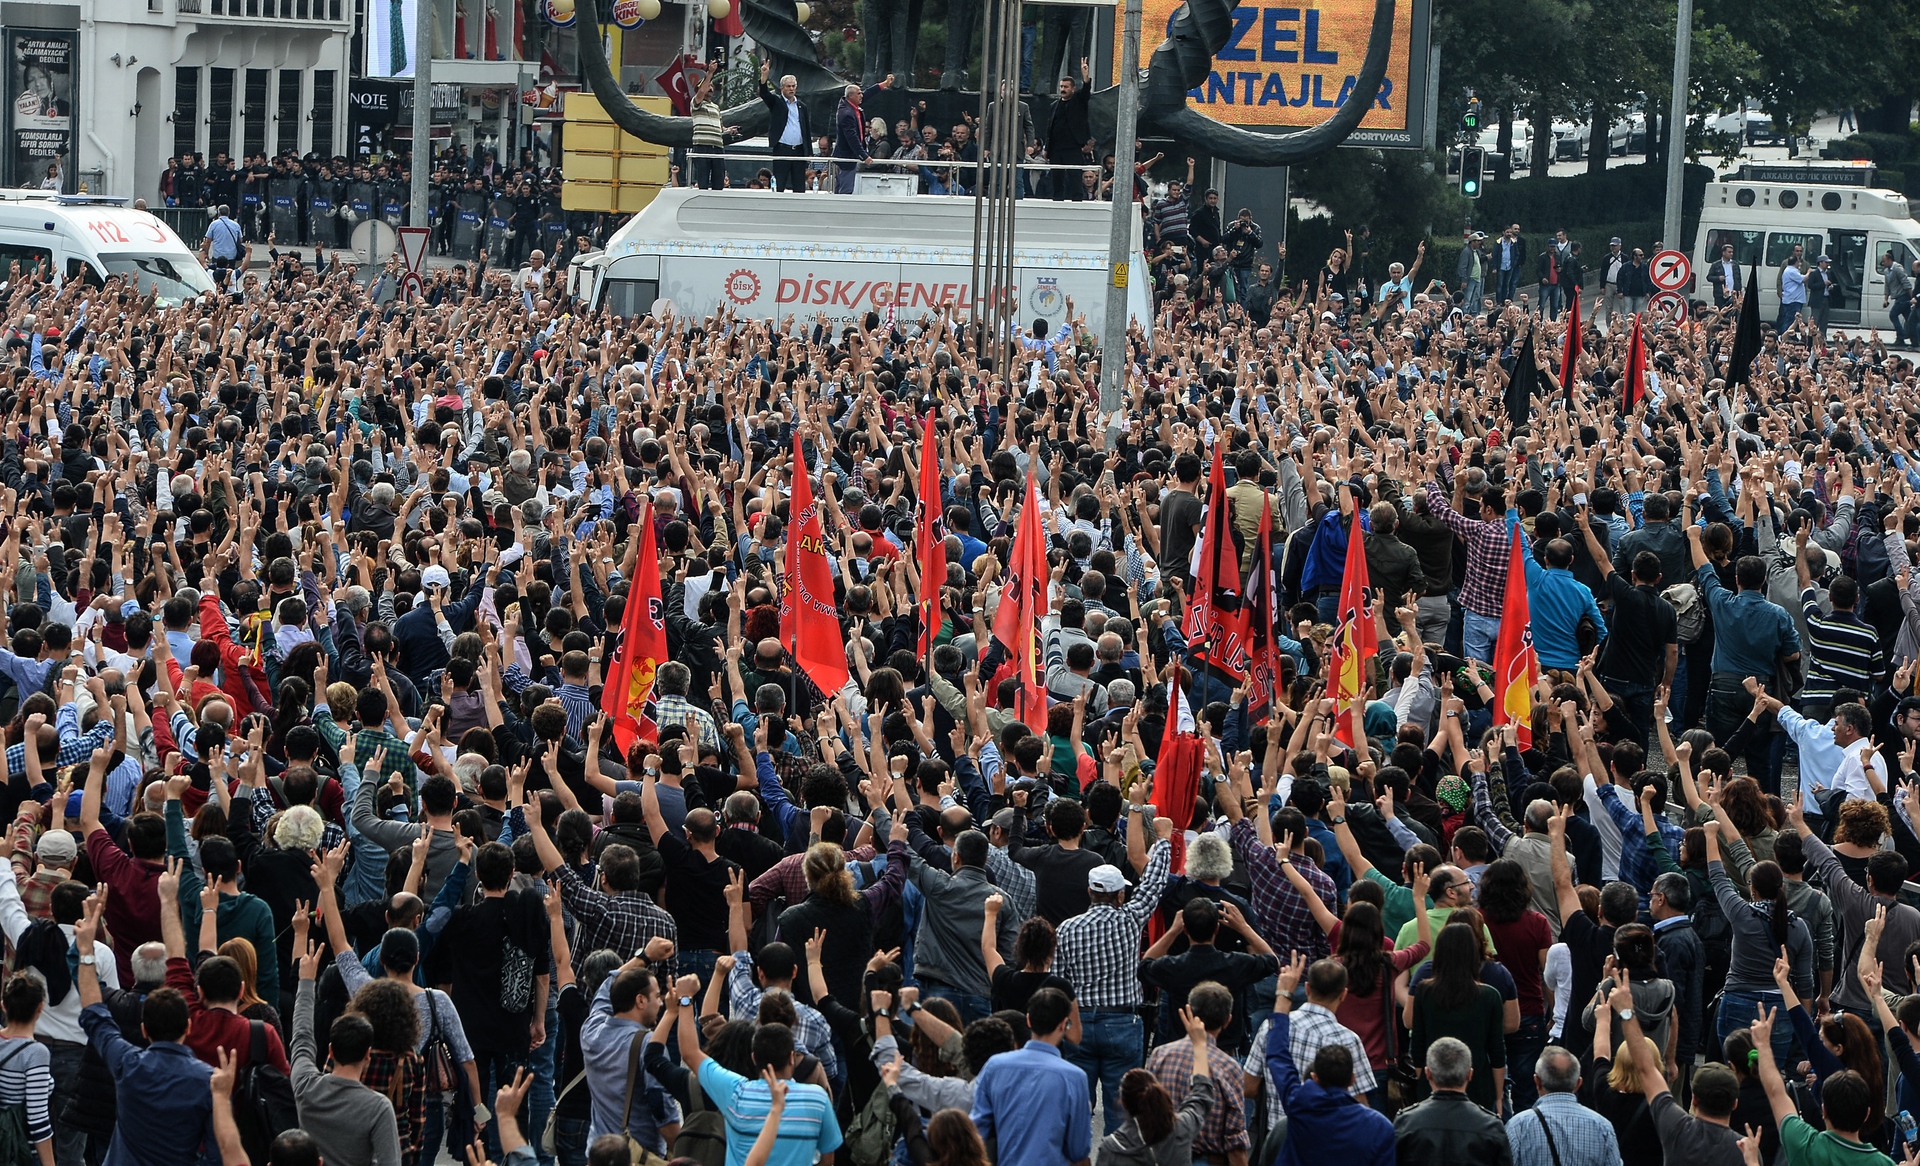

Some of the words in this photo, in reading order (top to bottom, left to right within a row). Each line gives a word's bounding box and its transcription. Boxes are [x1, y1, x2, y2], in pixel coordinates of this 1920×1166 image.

[1166, 7, 1339, 64] ZEL
[350, 92, 388, 106] NOTE
[1464, 116, 1476, 127] 40
[1761, 172, 1793, 180] ANKARA
[1822, 173, 1856, 181] KUVVET
[89, 221, 130, 243] 112
[733, 280, 753, 291] DİSK
